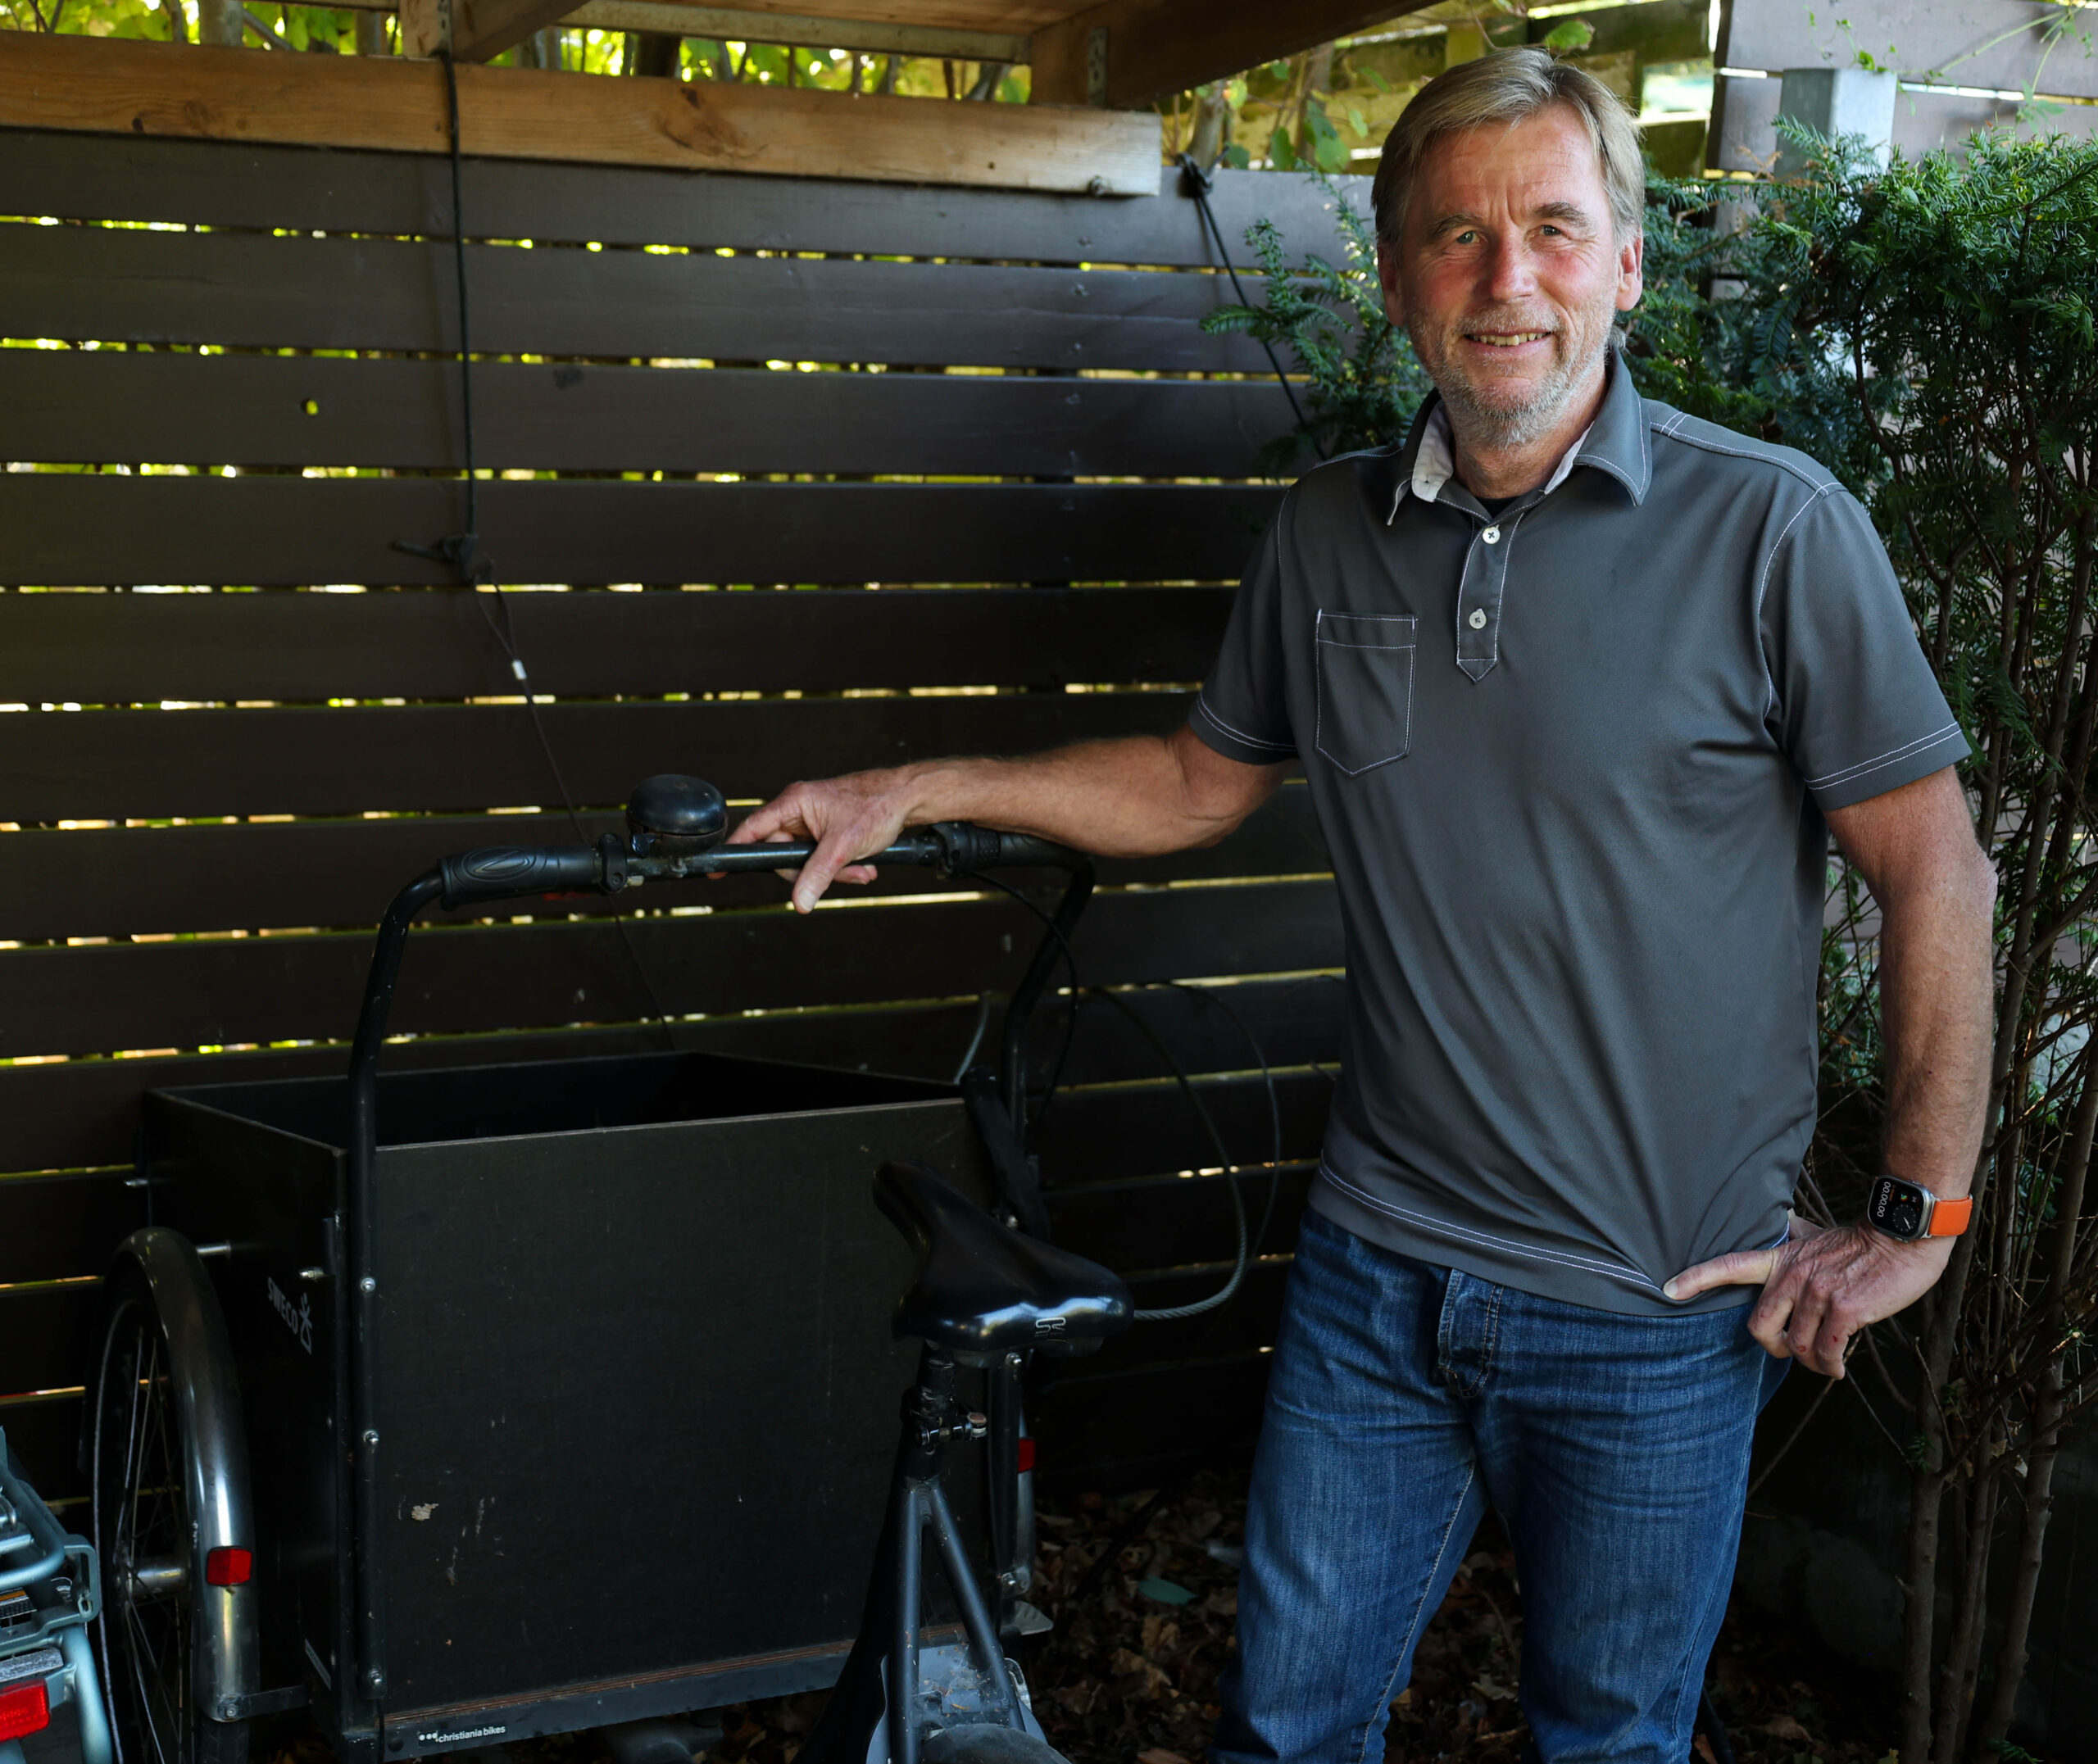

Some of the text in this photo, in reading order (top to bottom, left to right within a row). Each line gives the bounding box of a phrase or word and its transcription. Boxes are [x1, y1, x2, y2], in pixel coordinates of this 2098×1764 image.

[268, 1277, 297, 1334] SWECO
[438, 1725, 506, 1743] christiania bikes
